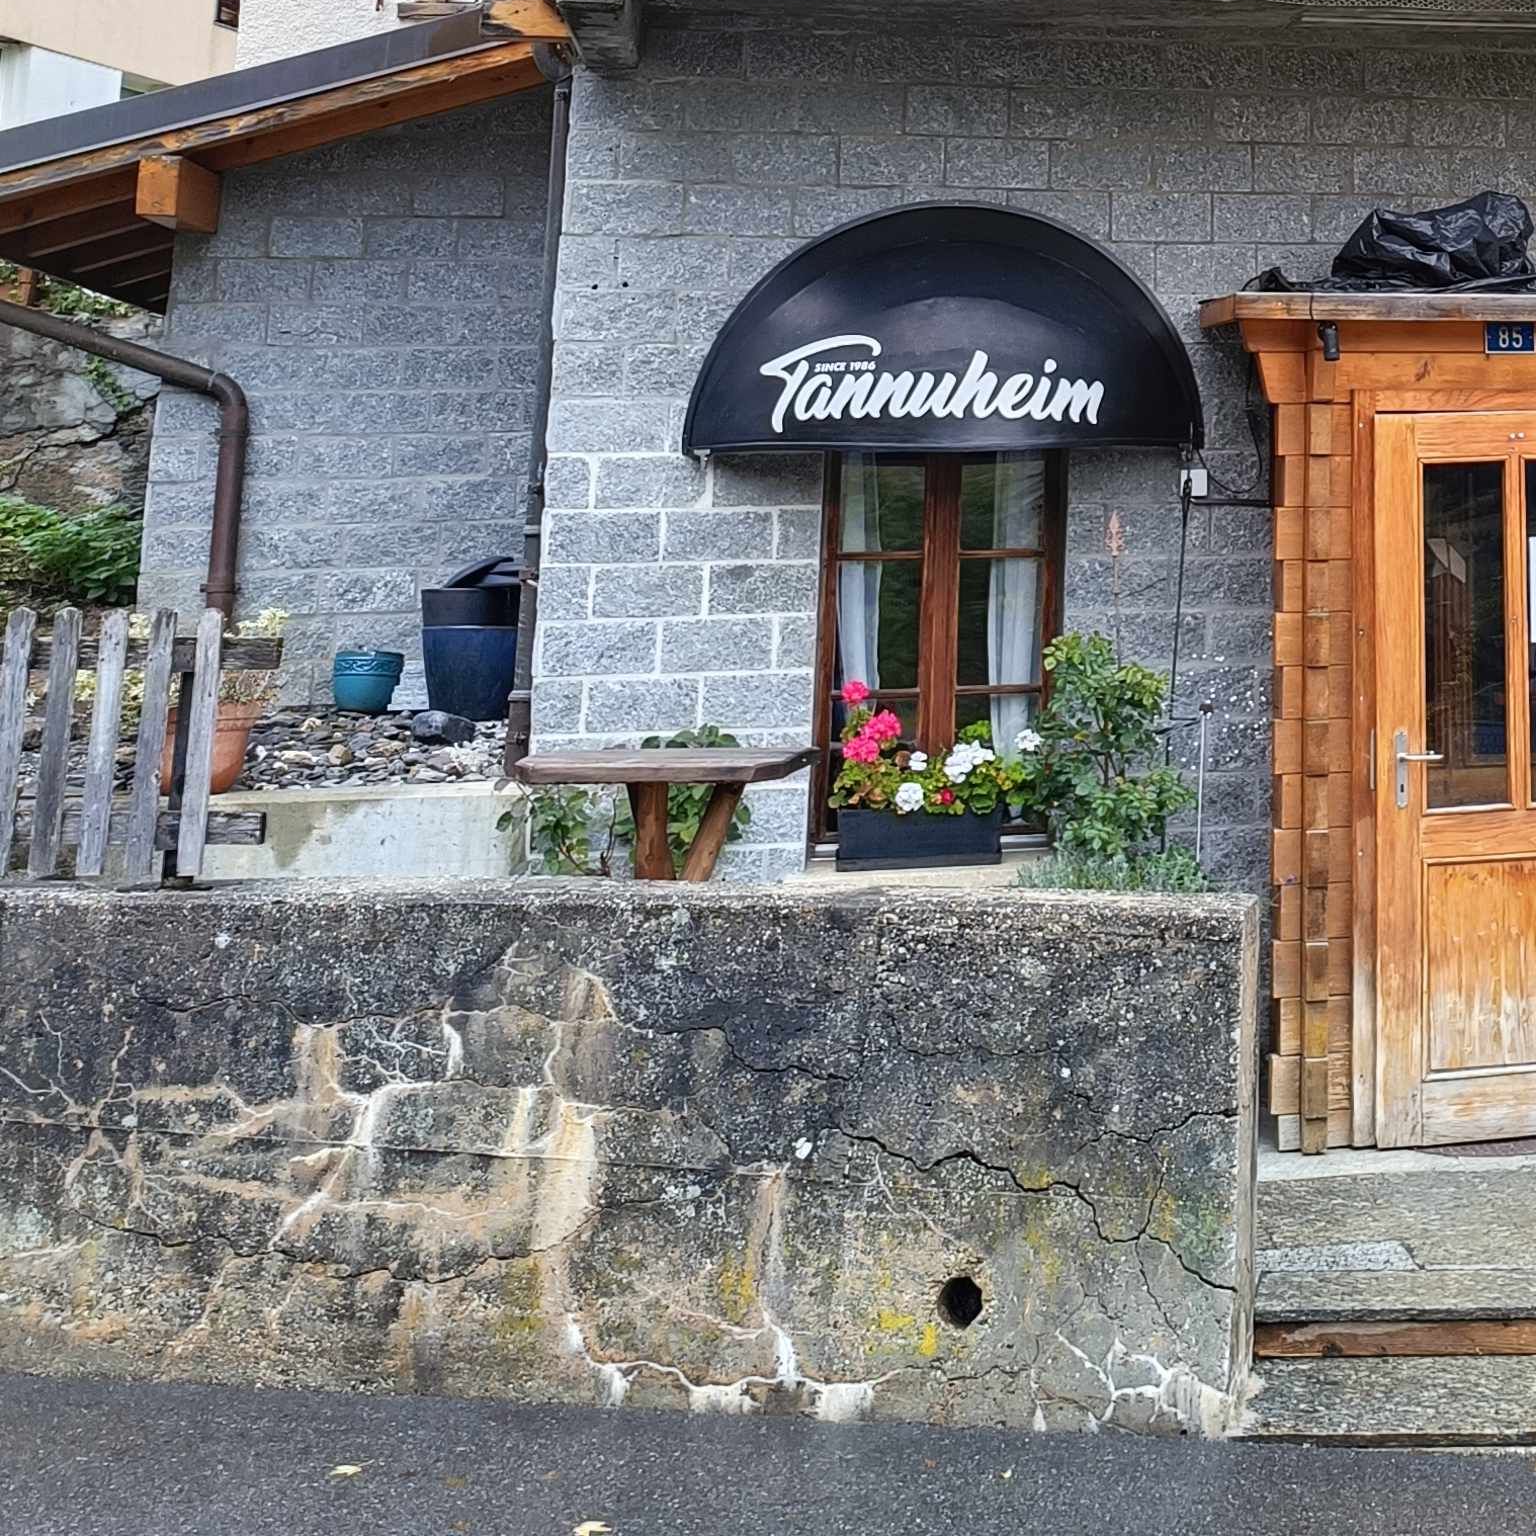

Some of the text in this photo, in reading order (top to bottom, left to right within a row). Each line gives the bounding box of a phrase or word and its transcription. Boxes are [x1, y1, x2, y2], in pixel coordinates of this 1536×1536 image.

[1498, 326, 1523, 349] 85
[814, 360, 877, 373] SINCE 1986
[759, 334, 1105, 433] Tannuheim
